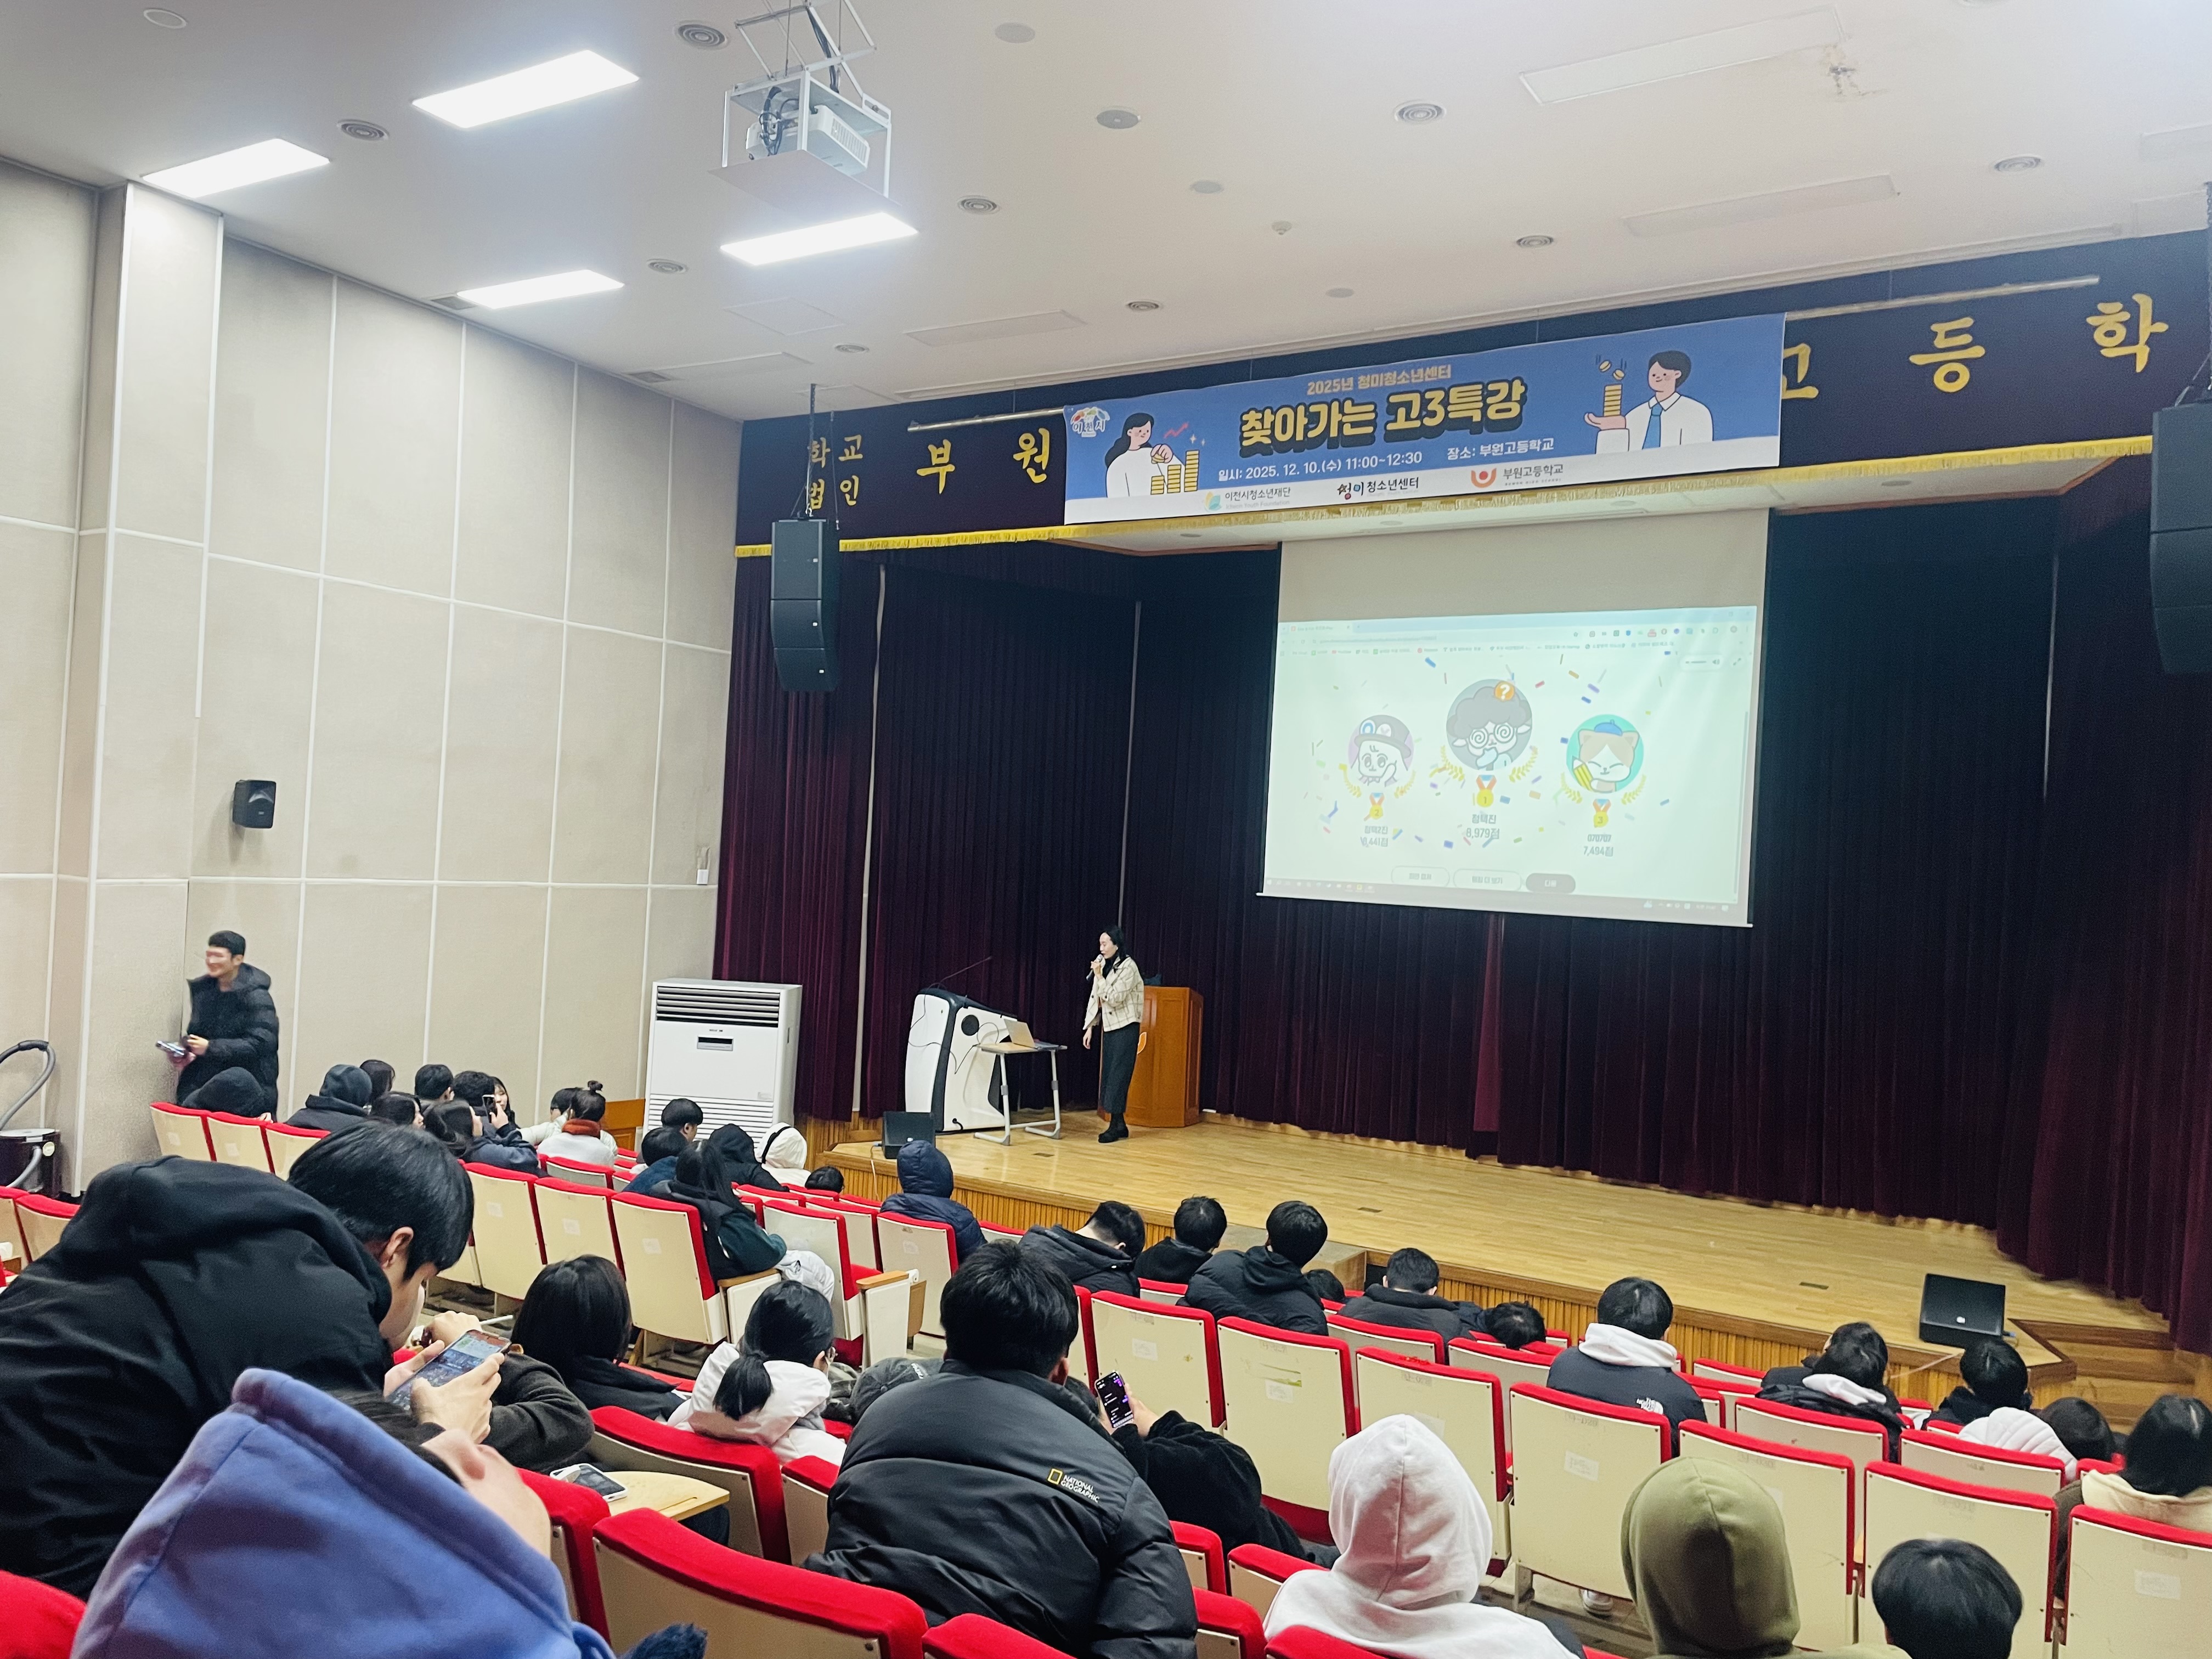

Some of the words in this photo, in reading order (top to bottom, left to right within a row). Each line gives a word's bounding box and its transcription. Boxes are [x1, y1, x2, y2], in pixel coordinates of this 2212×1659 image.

[1307, 376, 1353, 395] 2025년
[1241, 399, 1376, 447] 찾아가는
[1386, 379, 1525, 430] 고3특강
[1073, 420, 1105, 433] 이천시
[810, 434, 864, 468] 학교
[1447, 447, 1476, 460] 장소:
[1480, 438, 1554, 456] 부원고등학교
[1218, 469, 1243, 482] 일시:
[1246, 466, 1279, 479] 2025.
[1283, 464, 1300, 476] 12.
[1304, 459, 1341, 474] 10.(수)
[1346, 452, 1423, 470] 11:00~12:30
[1503, 464, 1563, 479] 부원고등학교
[1367, 477, 1419, 493] 청소년센터
[1224, 487, 1291, 501] 이천시청소년재단
[1483, 796, 1487, 804] 1
[1374, 809, 1379, 817] 2
[1466, 827, 1500, 839] 8,979점
[1587, 834, 1612, 842] 070707
[1583, 845, 1613, 857] 7,494점
[1063, 1474, 1094, 1493] NATIONAL
[1060, 1480, 1099, 1503] GEOGRAPHIC
